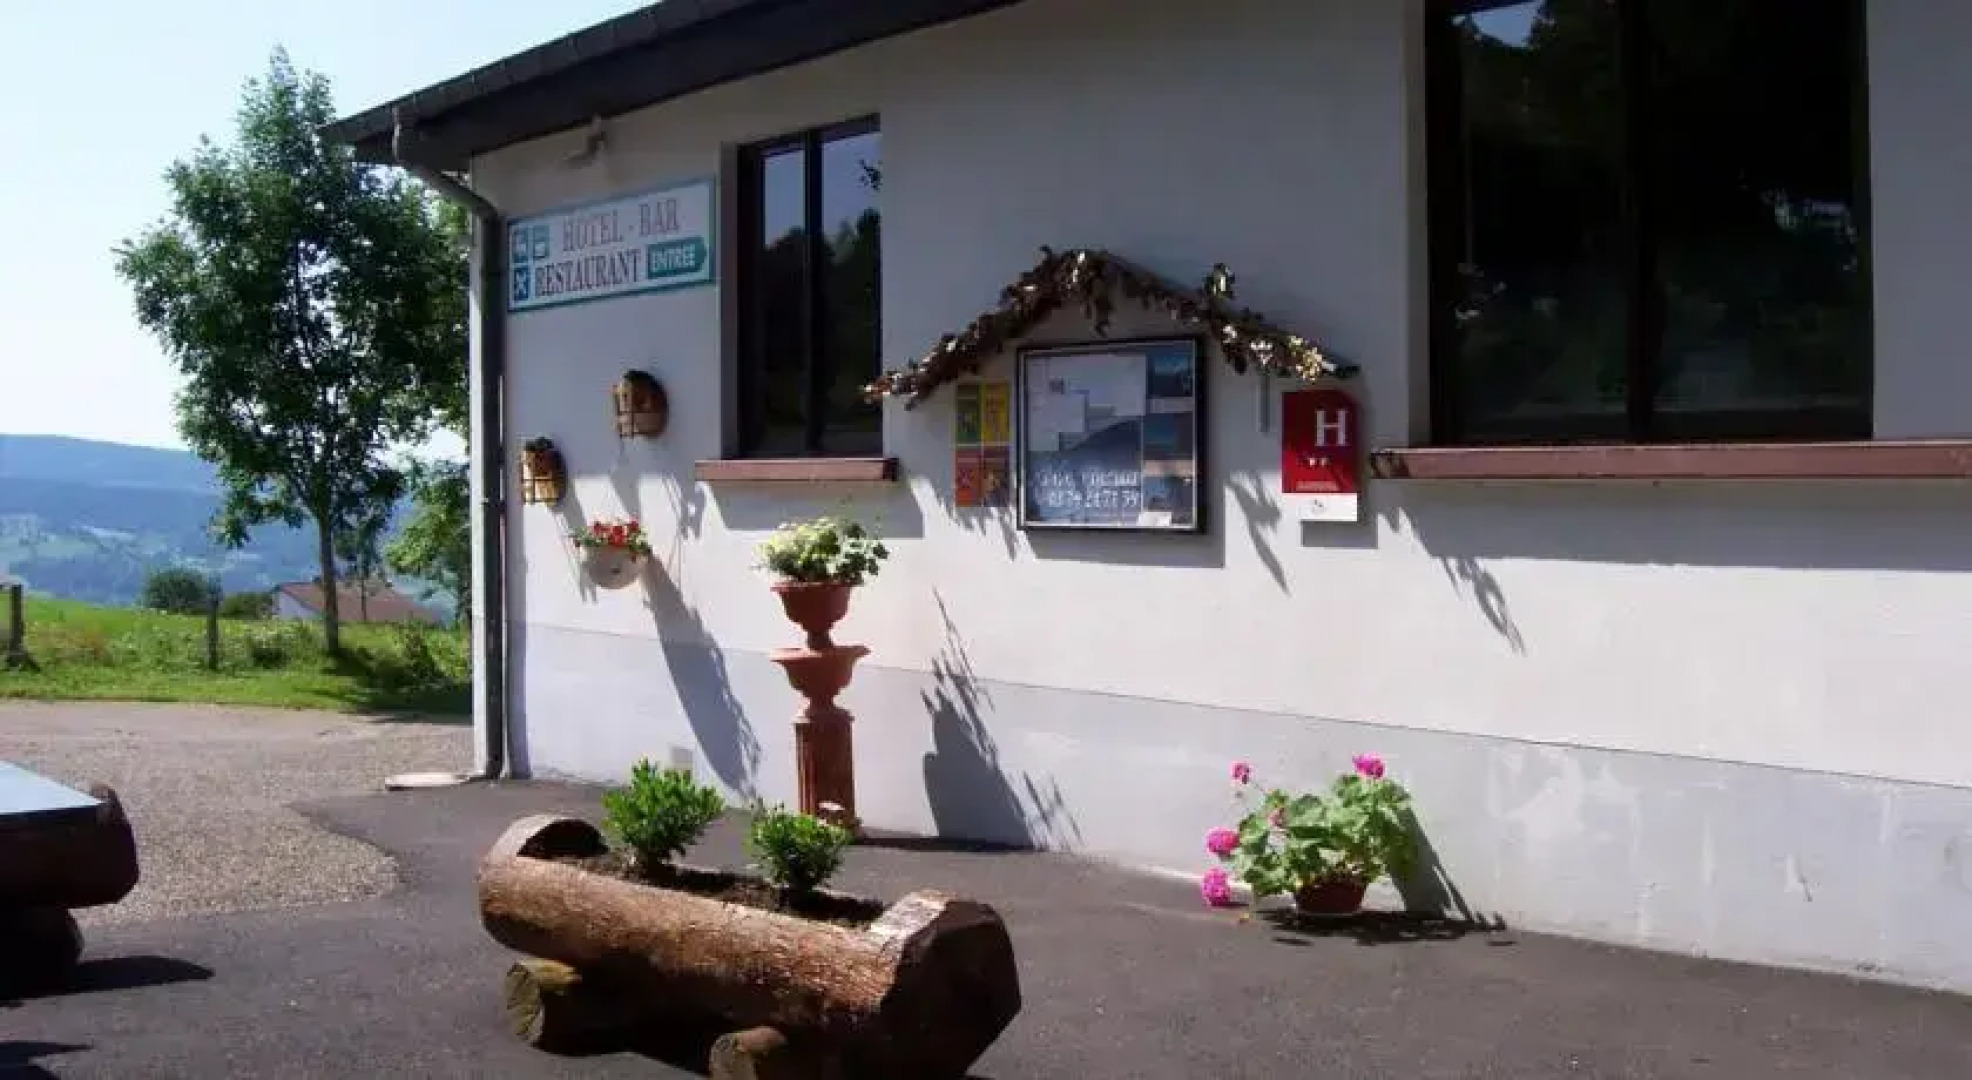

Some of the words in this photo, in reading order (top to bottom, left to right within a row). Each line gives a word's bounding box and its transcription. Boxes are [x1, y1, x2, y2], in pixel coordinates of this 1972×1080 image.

[639, 199, 680, 236] BAR
[534, 249, 641, 297] RESTAURANT
[1315, 410, 1349, 447] H
